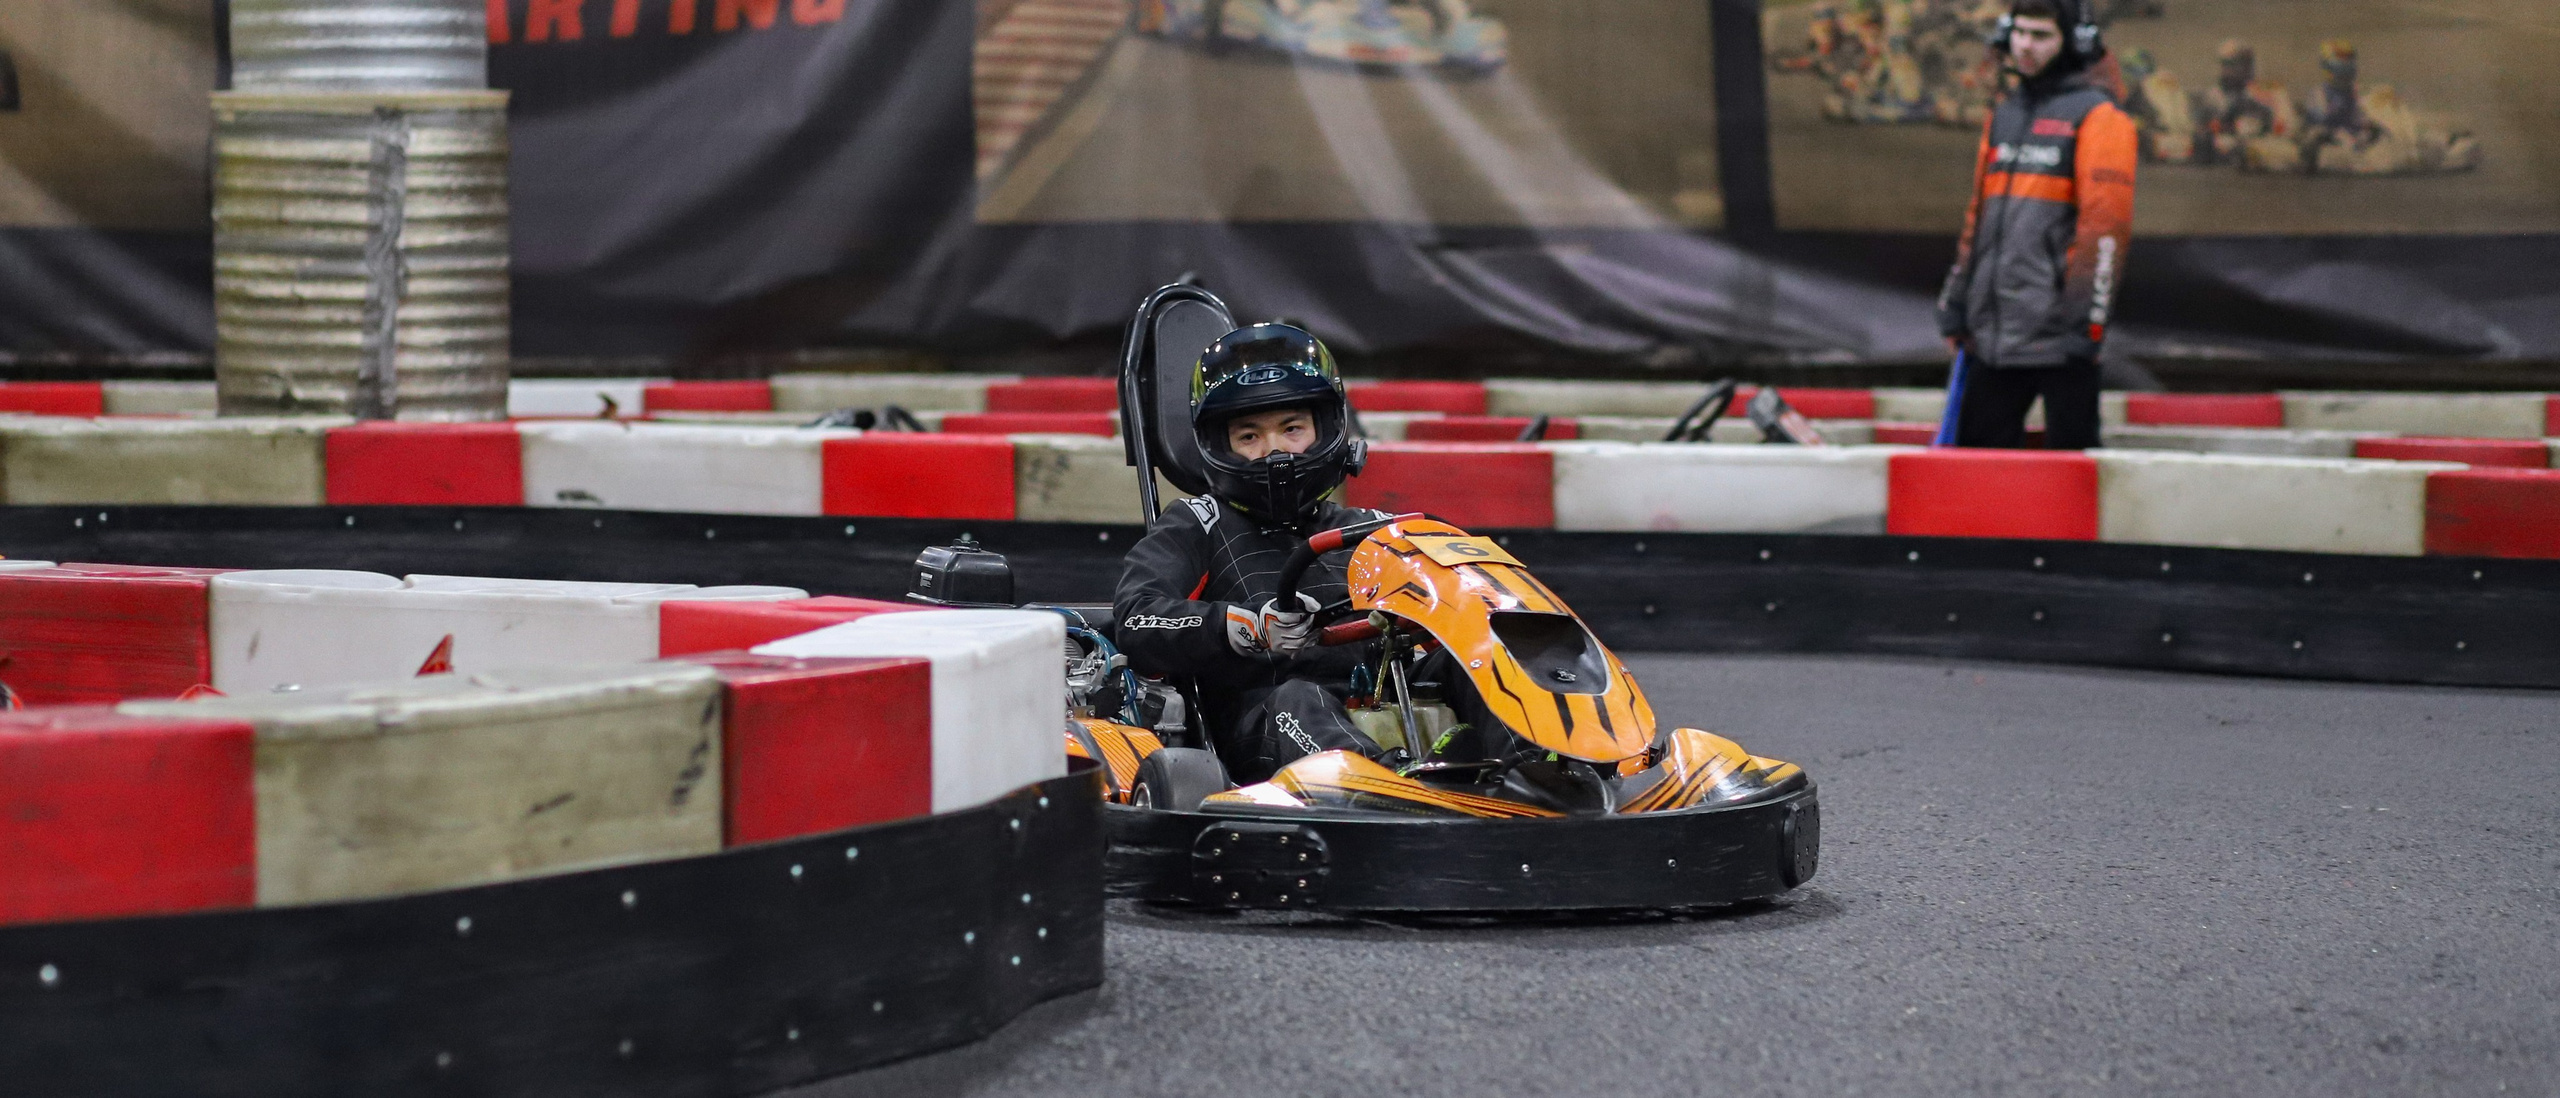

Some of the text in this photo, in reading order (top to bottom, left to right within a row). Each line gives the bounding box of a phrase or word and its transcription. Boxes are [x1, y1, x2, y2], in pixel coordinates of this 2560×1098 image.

[1244, 370, 1281, 383] HJC
[1446, 542, 1490, 557] 6
[1125, 615, 1203, 631] alpinestrs
